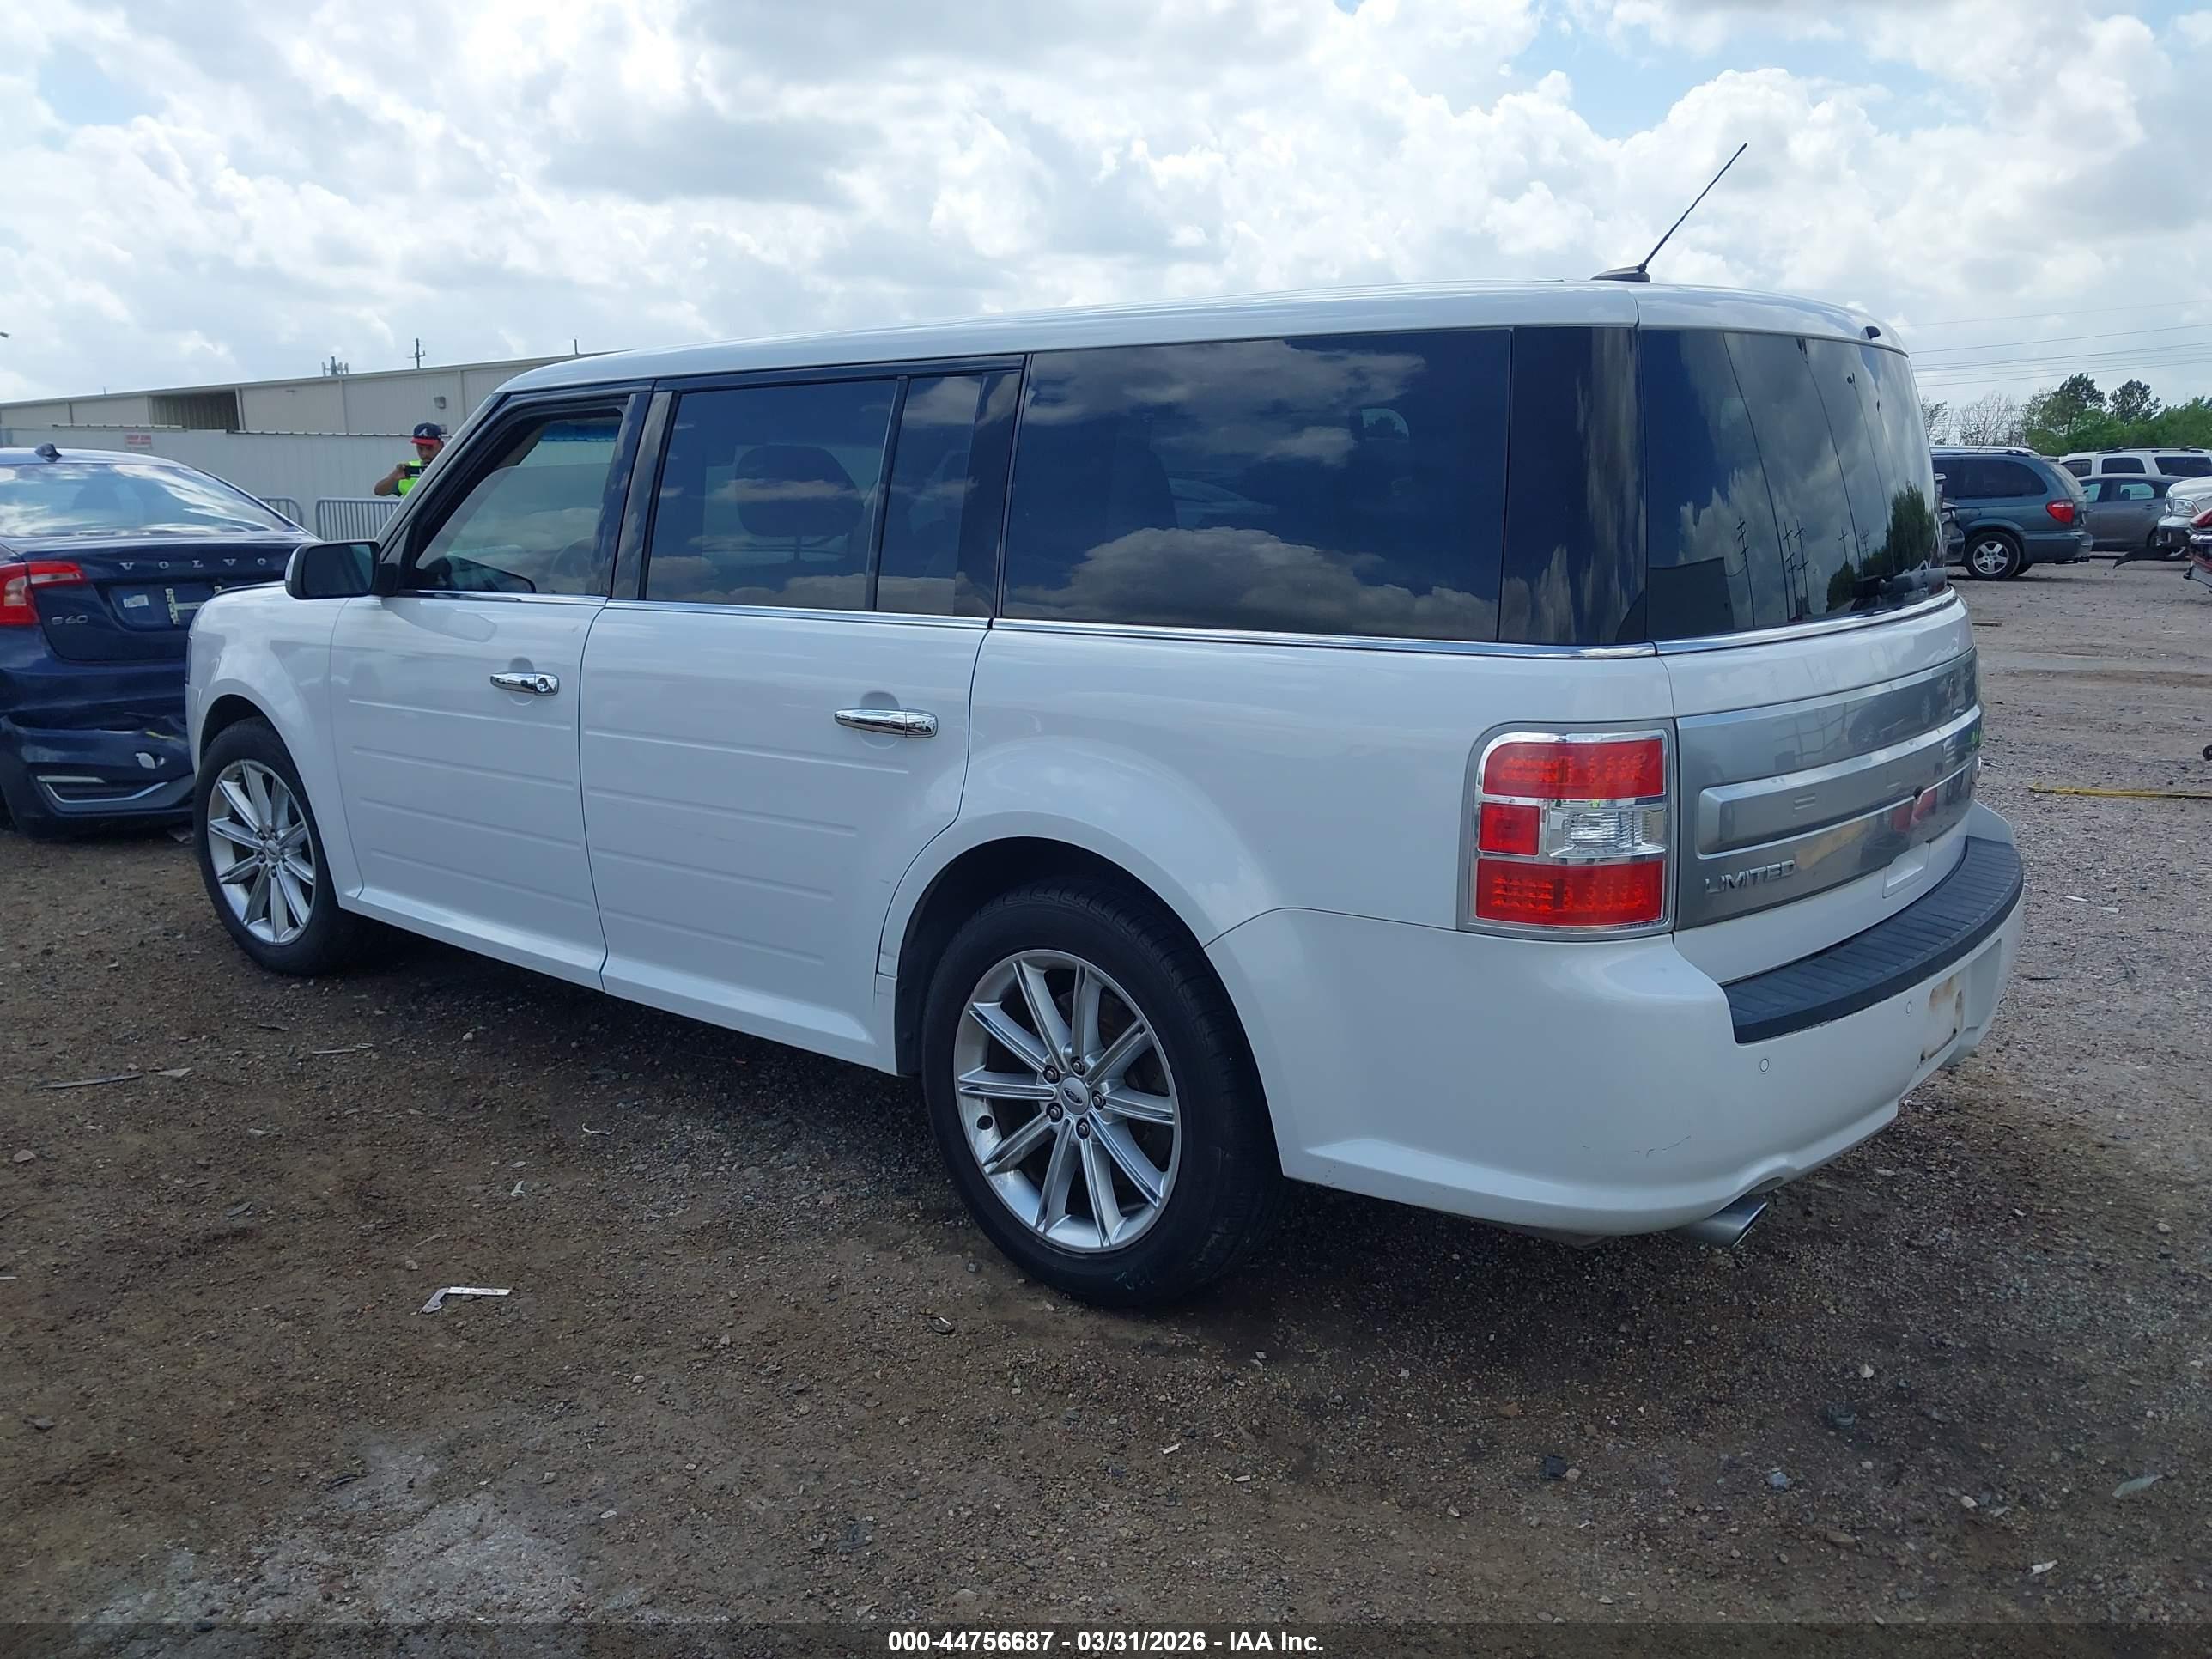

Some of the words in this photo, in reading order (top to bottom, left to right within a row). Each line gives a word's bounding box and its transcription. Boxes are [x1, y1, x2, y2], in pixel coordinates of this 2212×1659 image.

[118, 558, 267, 571] VOLVO
[52, 615, 88, 626] S60
[1704, 859, 1796, 894] LIMITED
